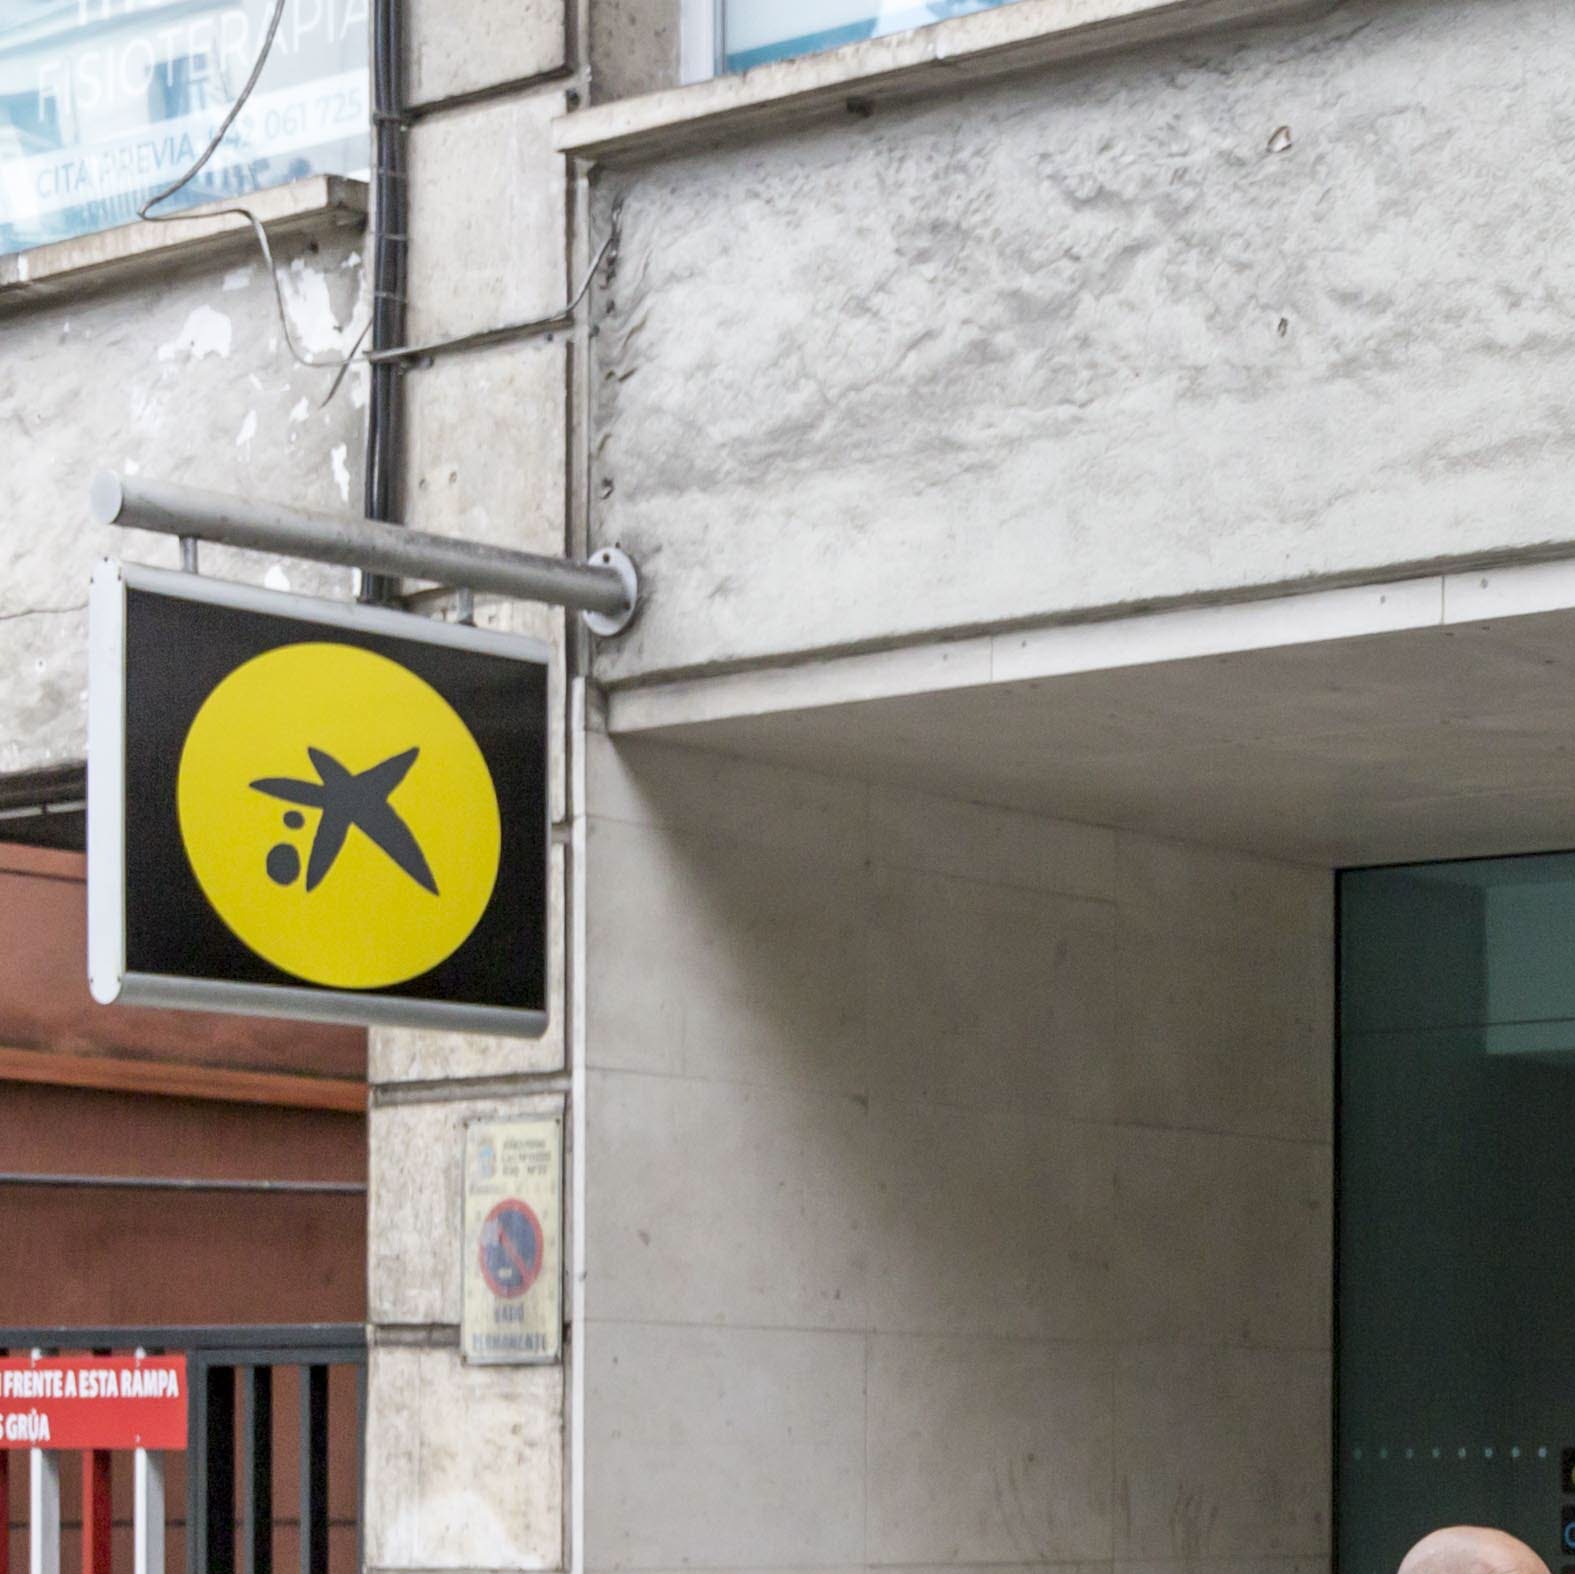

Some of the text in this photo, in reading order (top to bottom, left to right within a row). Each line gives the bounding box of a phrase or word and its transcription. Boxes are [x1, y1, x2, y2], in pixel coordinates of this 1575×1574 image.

[36, 159, 96, 199] CITA
[100, 131, 197, 187] PREVIA
[3, 1369, 64, 1398] FRENTE
[64, 1369, 77, 1398] A
[78, 1369, 119, 1398] ESTA
[120, 1368, 179, 1398] RAMPA
[6, 1408, 51, 1441] GRÚA
